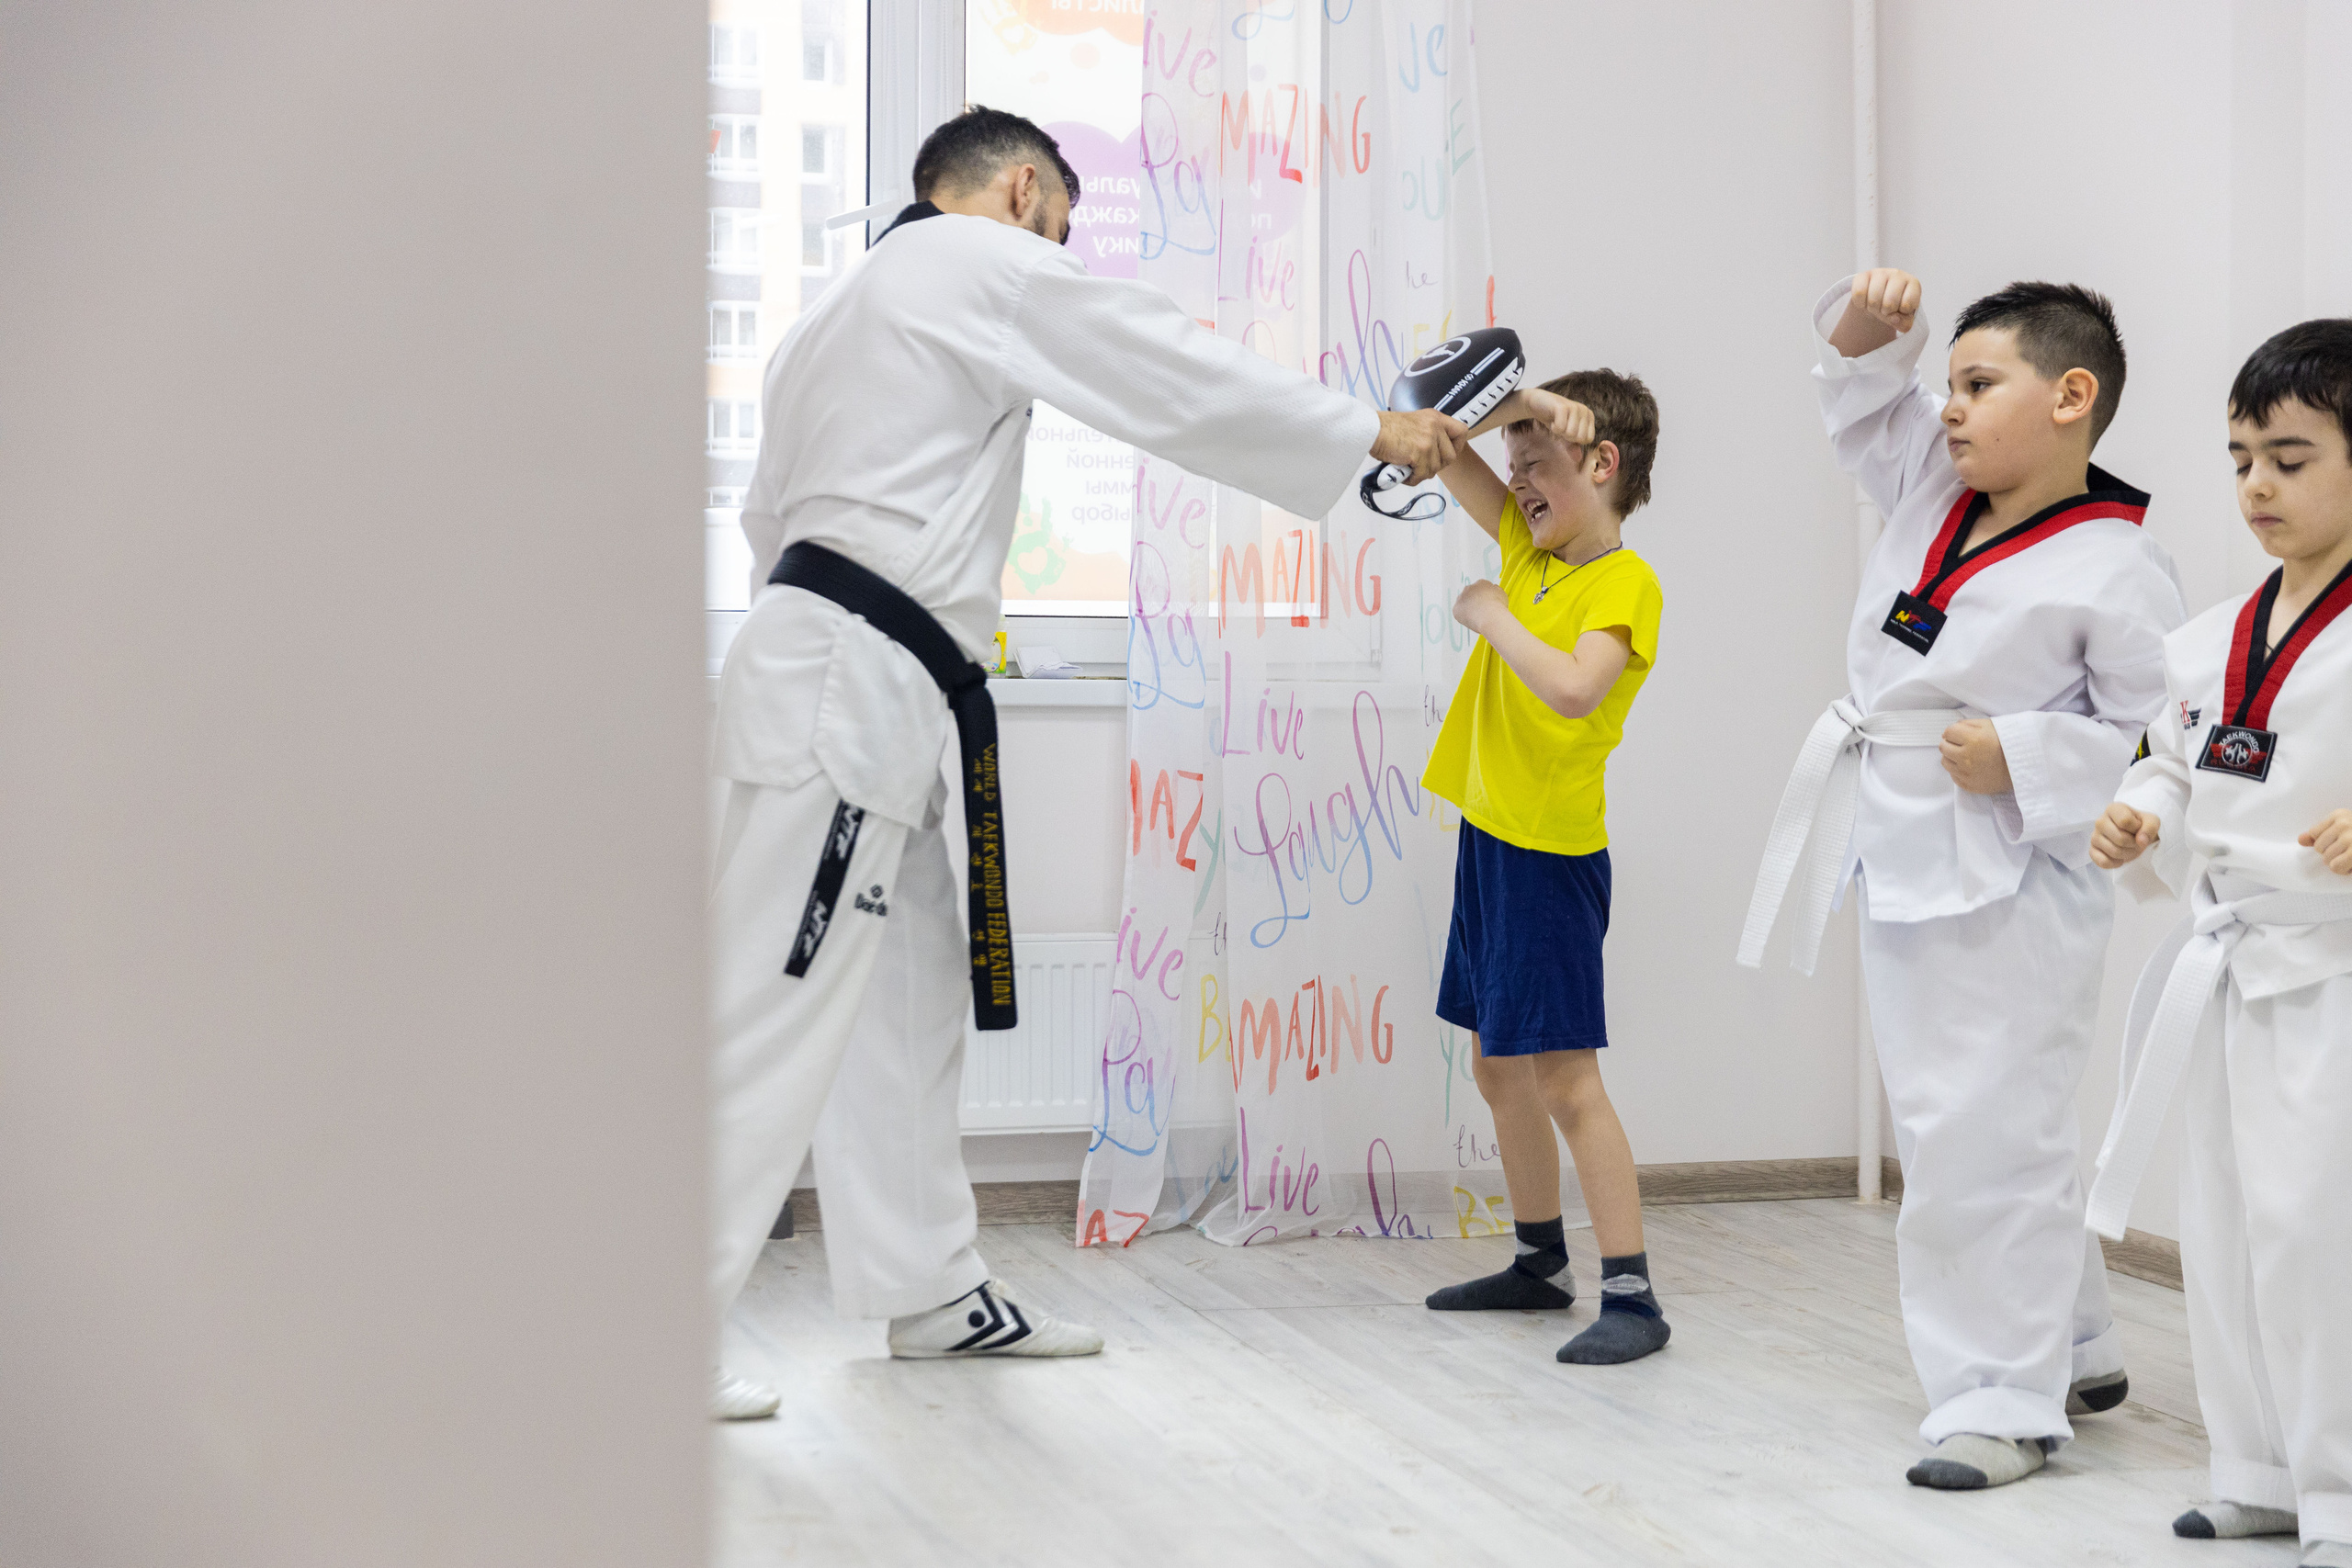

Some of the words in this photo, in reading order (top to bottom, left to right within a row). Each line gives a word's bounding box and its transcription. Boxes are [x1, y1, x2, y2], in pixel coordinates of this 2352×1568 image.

[1142, 10, 1217, 98] ive
[1220, 84, 1372, 187] MAZING
[1133, 457, 1206, 549] ive
[1218, 529, 1382, 639] MAZING
[1222, 650, 1305, 761] Live
[2218, 730, 2260, 754] TAEKWONDO
[982, 742, 997, 802] WORLD
[1234, 690, 1420, 949] Laugh
[983, 812, 1004, 908] TAEKWONDO
[987, 912, 1012, 1006] FEDERATION
[1115, 907, 1183, 1001] ive
[1228, 975, 1394, 1096] MAZING
[1240, 1106, 1320, 1216] Live
